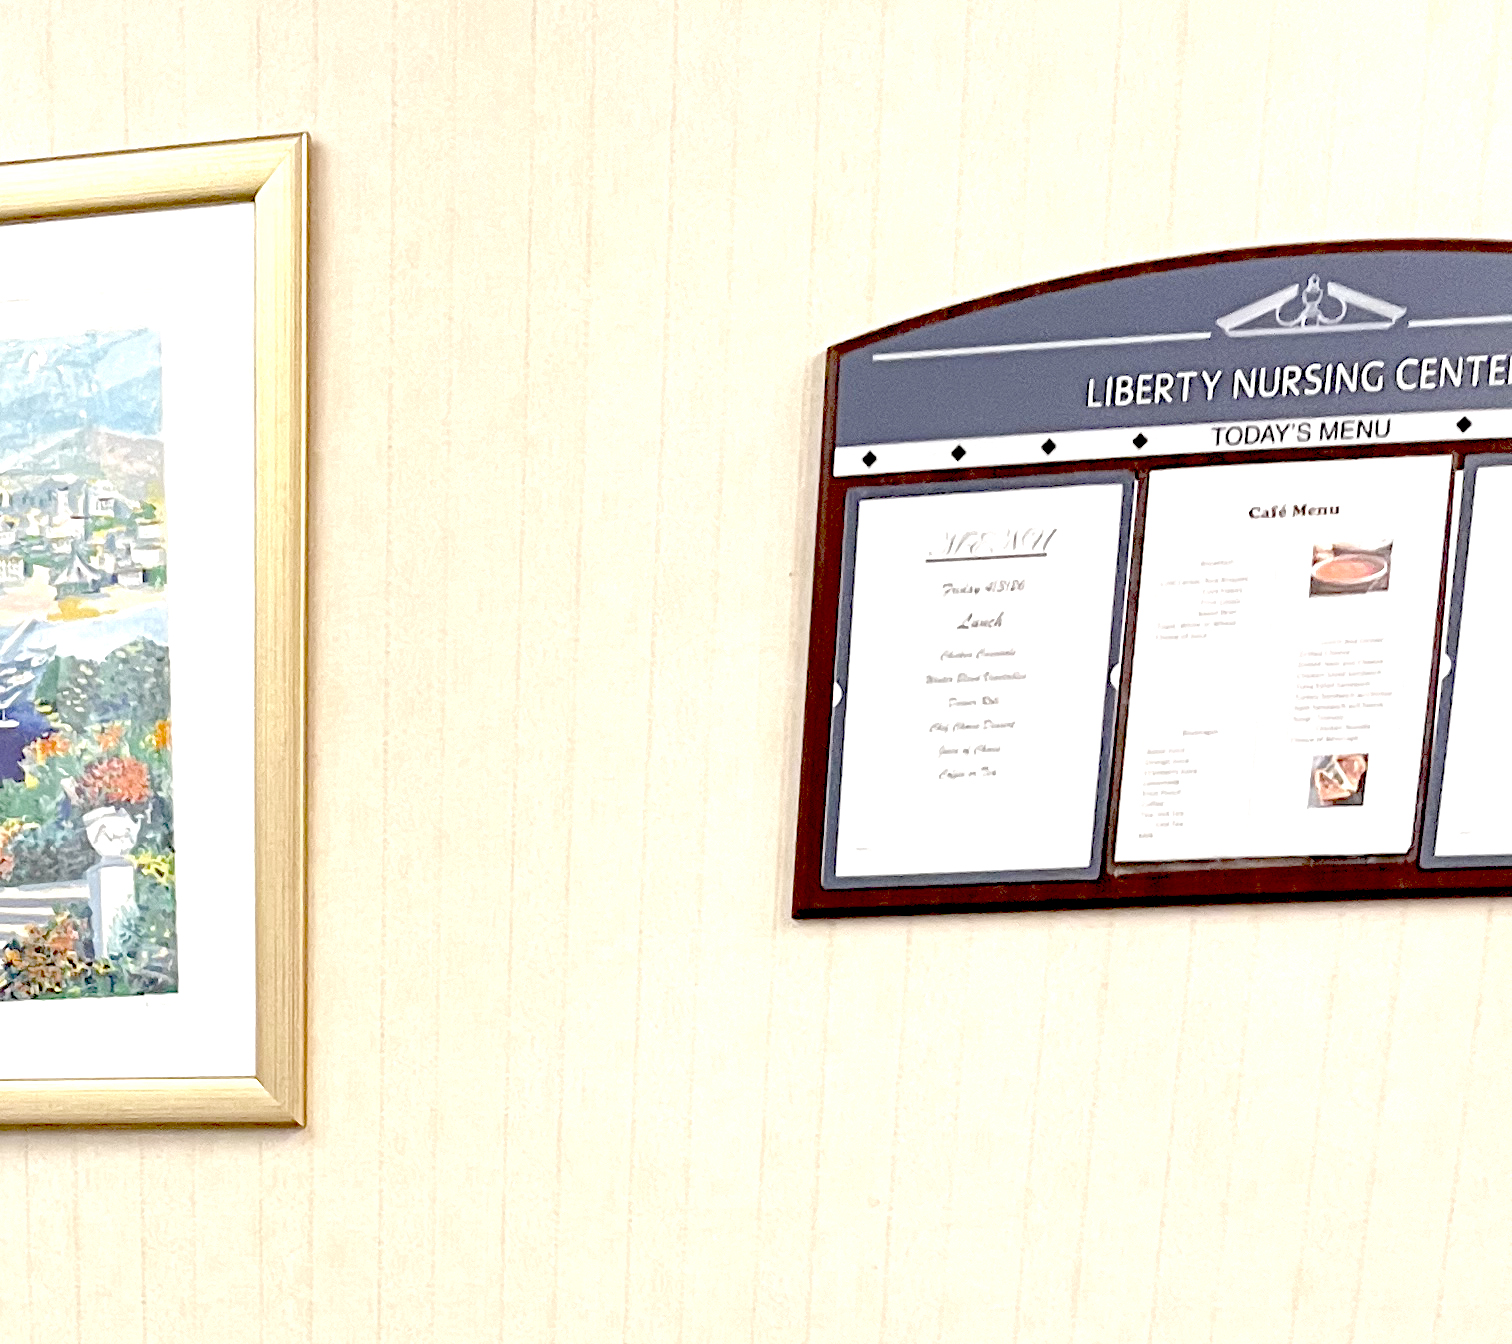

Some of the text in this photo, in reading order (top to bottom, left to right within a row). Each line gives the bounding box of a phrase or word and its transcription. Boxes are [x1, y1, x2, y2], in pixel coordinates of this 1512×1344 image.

[1086, 353, 1512, 408] LIBERTY NURSING CENTE
[1211, 418, 1392, 447] TODAY'S MENU
[1248, 503, 1341, 520] Café Menu
[956, 611, 1006, 630] Lunch
